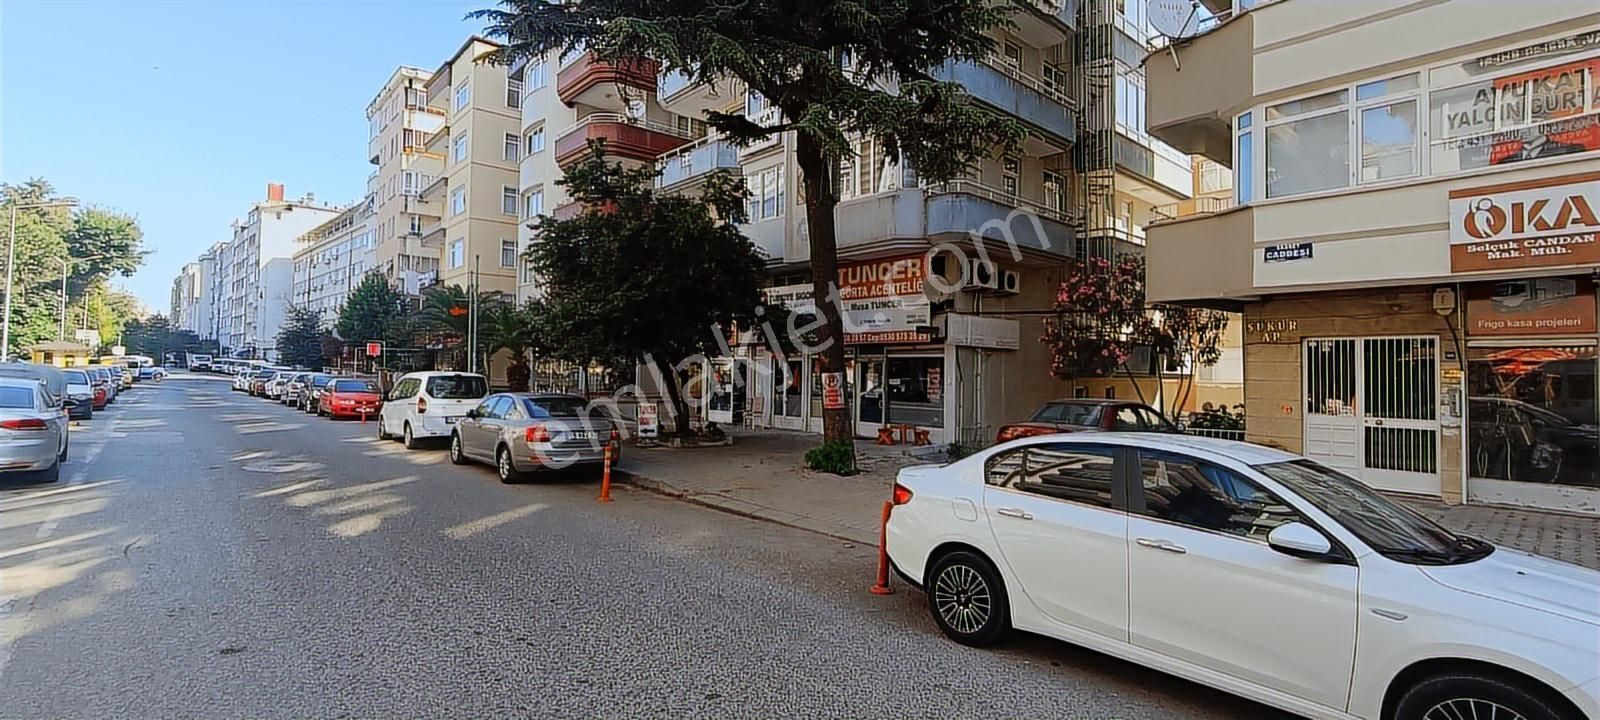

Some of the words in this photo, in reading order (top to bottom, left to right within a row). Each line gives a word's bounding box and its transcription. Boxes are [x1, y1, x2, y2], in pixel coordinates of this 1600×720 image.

[1467, 241, 1520, 253] Selçuk
[1524, 234, 1596, 248] CANDAN
[1487, 250, 1525, 260] Mak.
[1531, 246, 1572, 256] Müh.
[1478, 319, 1505, 330] Frigo
[1507, 319, 1533, 328] kasa
[1535, 317, 1581, 328] projeleri
